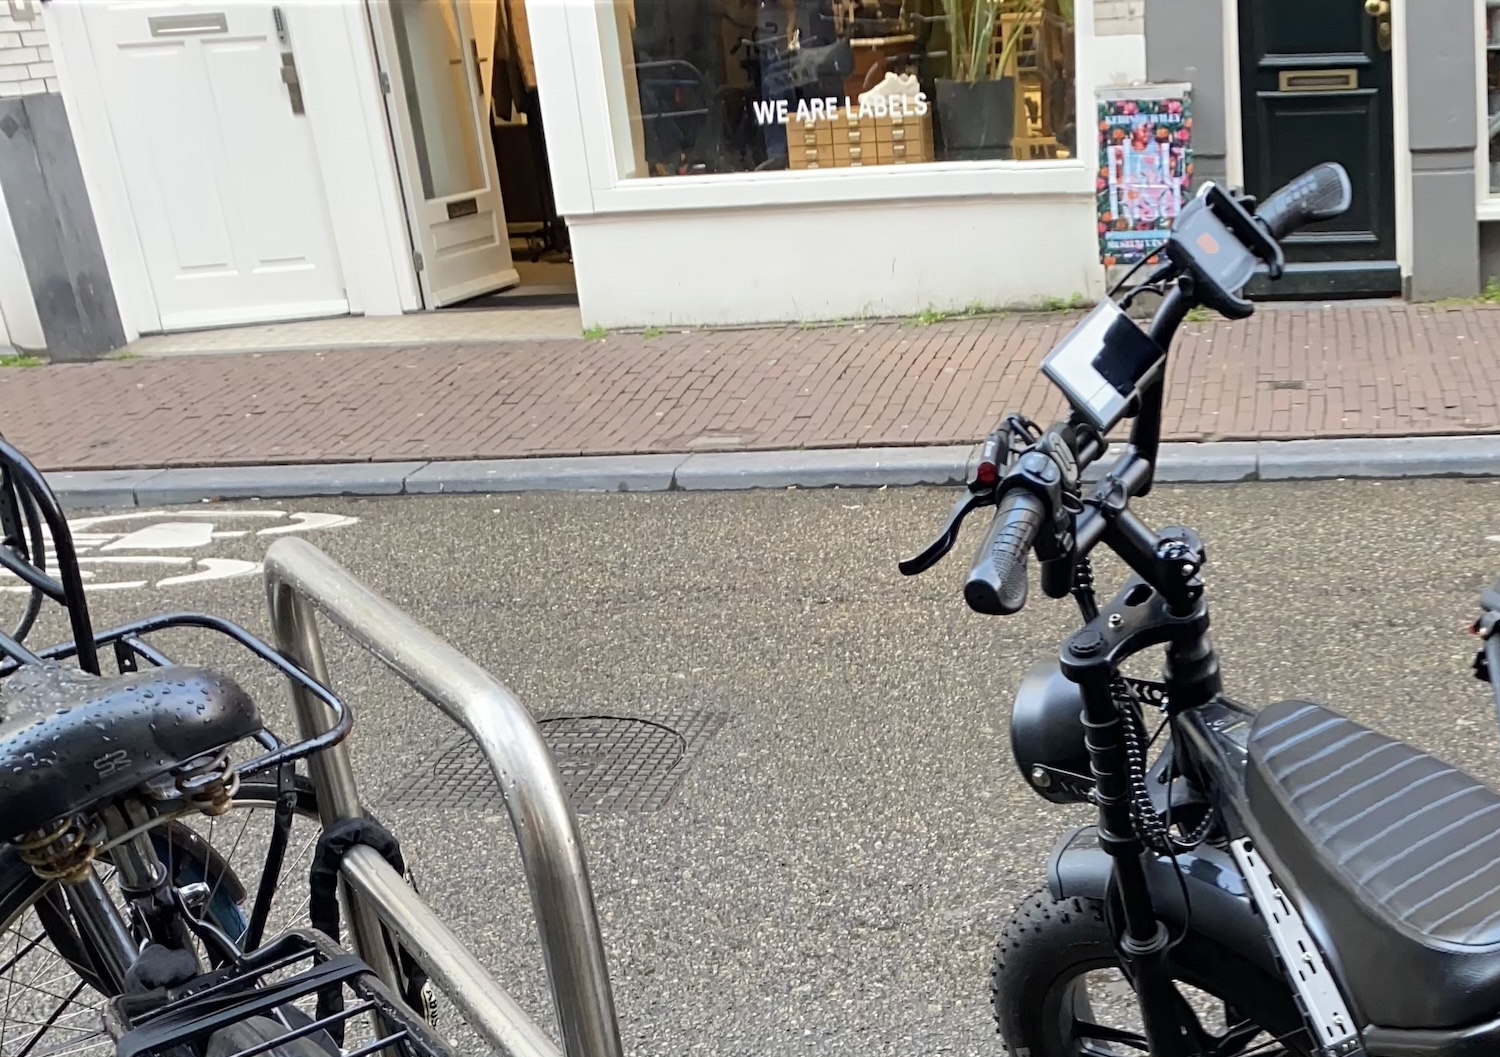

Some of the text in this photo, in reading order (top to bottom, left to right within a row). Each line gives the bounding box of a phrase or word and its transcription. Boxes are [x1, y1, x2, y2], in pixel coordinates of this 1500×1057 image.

[753, 91, 928, 125] WE ARE LABELS
